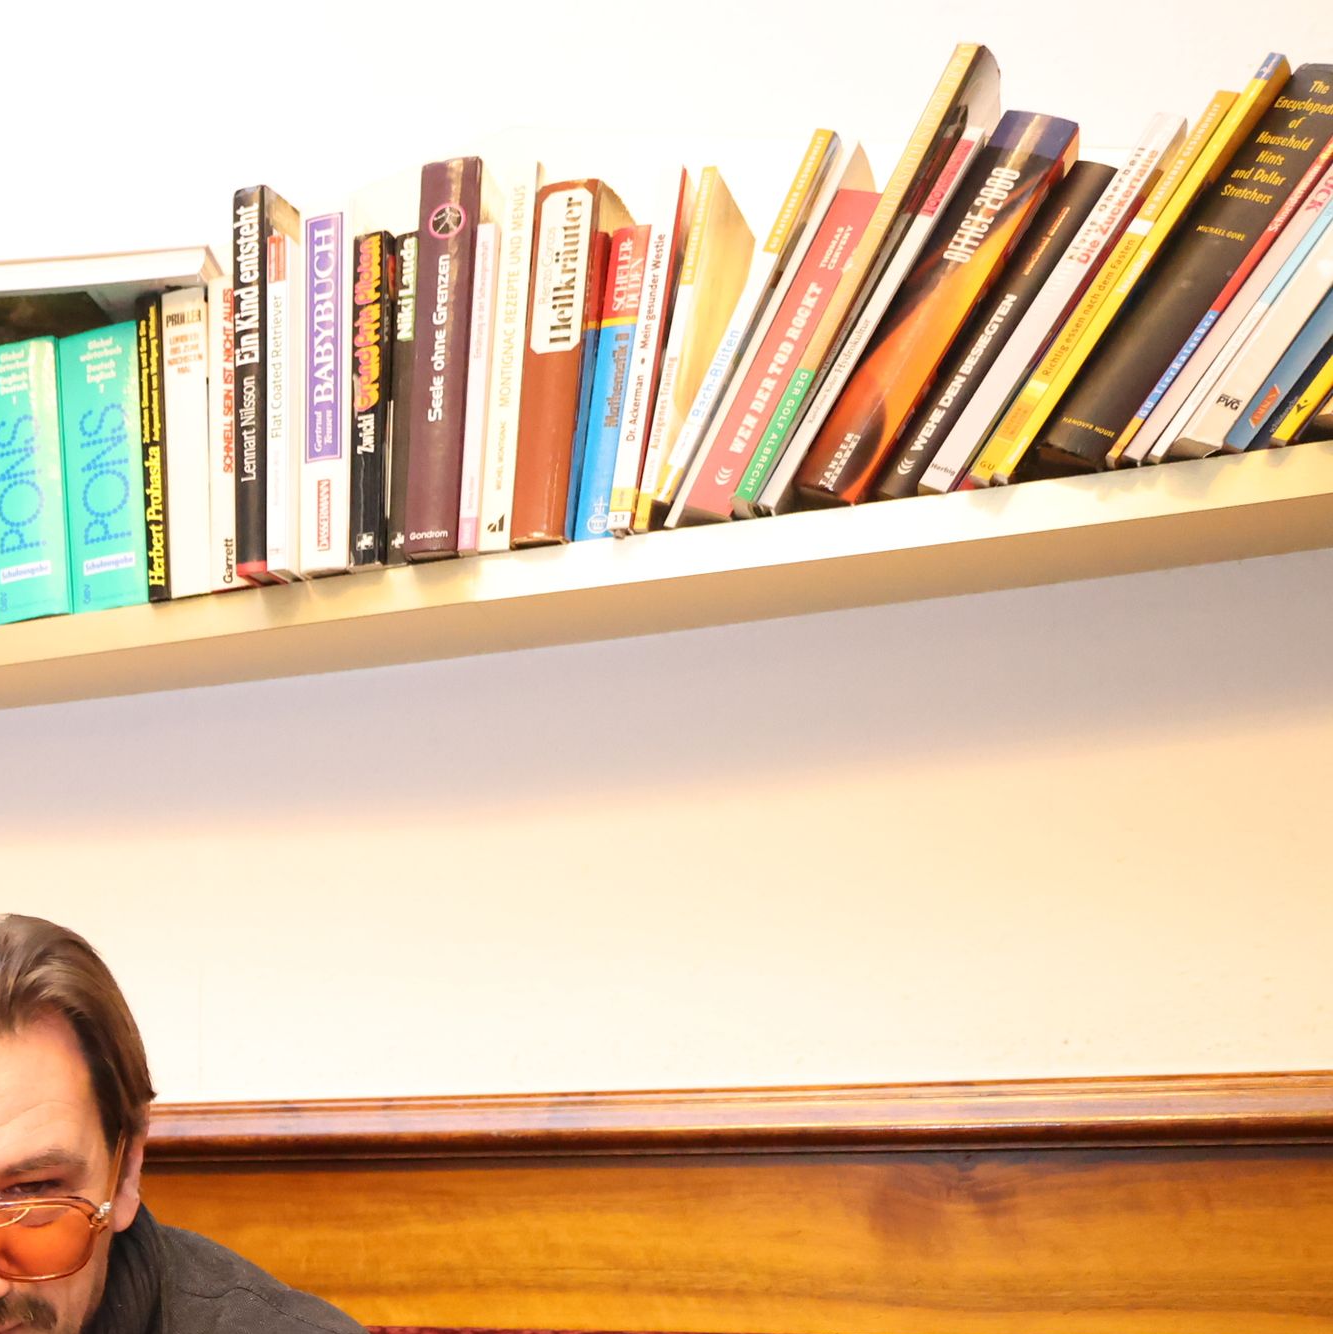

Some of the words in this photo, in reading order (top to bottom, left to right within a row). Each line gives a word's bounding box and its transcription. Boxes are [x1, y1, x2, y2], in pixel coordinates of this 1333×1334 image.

[1274, 96, 1333, 115] Encycloped
[1309, 80, 1330, 94] The
[1255, 131, 1314, 151] Household
[1288, 116, 1306, 129] of
[793, 135, 827, 191] GESUNDHEIT
[1231, 167, 1251, 180] and
[1253, 168, 1286, 186] Dollar
[1256, 150, 1285, 166] Hints
[509, 184, 526, 231] MENUS
[772, 191, 800, 236] RATGEBER
[943, 201, 994, 265] OFFICE
[979, 166, 1020, 218] 2000
[1076, 236, 1101, 266] Die
[1095, 147, 1161, 236] Zuckerfalle
[1221, 184, 1273, 205] Stretchers
[233, 202, 260, 283] entsteht
[507, 235, 522, 265] UND
[650, 233, 666, 271] Westie
[767, 235, 779, 249] GU
[818, 224, 845, 269] THOMAS
[826, 224, 854, 270] CERVENY
[1196, 225, 1225, 237] MICHAEL
[353, 233, 383, 307] Piloten
[397, 236, 417, 294] Lauda
[548, 197, 583, 344] Heilkräuter
[625, 257, 643, 309] DUDEN
[222, 288, 234, 322] ALLES
[232, 284, 259, 333] Kind
[433, 254, 450, 324] Grenzen
[502, 270, 520, 324] REZEPTE
[643, 273, 662, 321] gesunder
[1041, 343, 1069, 378] Richtig
[1064, 316, 1086, 345] essen
[1080, 291, 1101, 316] nach
[1096, 269, 1115, 292] dem
[1110, 236, 1136, 271] Fasten
[270, 295, 283, 357] Retriever
[312, 225, 336, 406] BABYBUCH
[353, 302, 381, 349] Prix
[395, 298, 414, 340] Niki
[639, 322, 652, 349] Mein
[222, 328, 234, 362] NICHT
[234, 332, 259, 366] Ein
[431, 329, 446, 370] ohne
[496, 328, 516, 407] MONTIGNAC
[729, 412, 758, 455] WEN
[749, 374, 777, 415] DER
[767, 338, 795, 378] TOD
[784, 280, 823, 342] ROCKT
[833, 316, 871, 375] Hydrokultur
[222, 367, 233, 384] IST
[269, 362, 283, 409] Coated
[350, 344, 381, 412] Grand
[601, 343, 630, 429] Mathematik
[657, 355, 679, 396] Training
[790, 370, 809, 397] DER
[909, 405, 946, 455] WEHE
[938, 372, 967, 409] DEN
[958, 290, 1018, 376] BESIEGTEN
[223, 389, 233, 416] SEIN
[238, 375, 257, 427] Nilsson
[427, 375, 444, 422] Seele
[627, 374, 645, 425] Ackerman
[773, 397, 795, 431] GOLF
[1138, 399, 1155, 418] GU
[1216, 395, 1241, 411] PVG
[222, 420, 233, 472] SCHNELL
[270, 413, 282, 438] Flat
[313, 411, 323, 452] Gertrud
[323, 409, 333, 444] Teusen
[355, 411, 378, 456] Zwickl
[625, 427, 636, 442] Dr.
[645, 399, 671, 450] Autogenes
[1063, 417, 1094, 434] HANOVER
[1094, 424, 1116, 438] HOUSE
[79, 402, 132, 545] PONS
[239, 428, 257, 482] Lennart
[743, 430, 779, 494] ALBRECHT
[818, 431, 855, 490] TANDEM
[979, 459, 995, 471] GU
[144, 446, 163, 521] Prohaska
[315, 480, 331, 550] BASSERMANN
[409, 530, 448, 541] Gondrom
[147, 523, 165, 586] Herbert
[222, 538, 235, 583] Garrett
